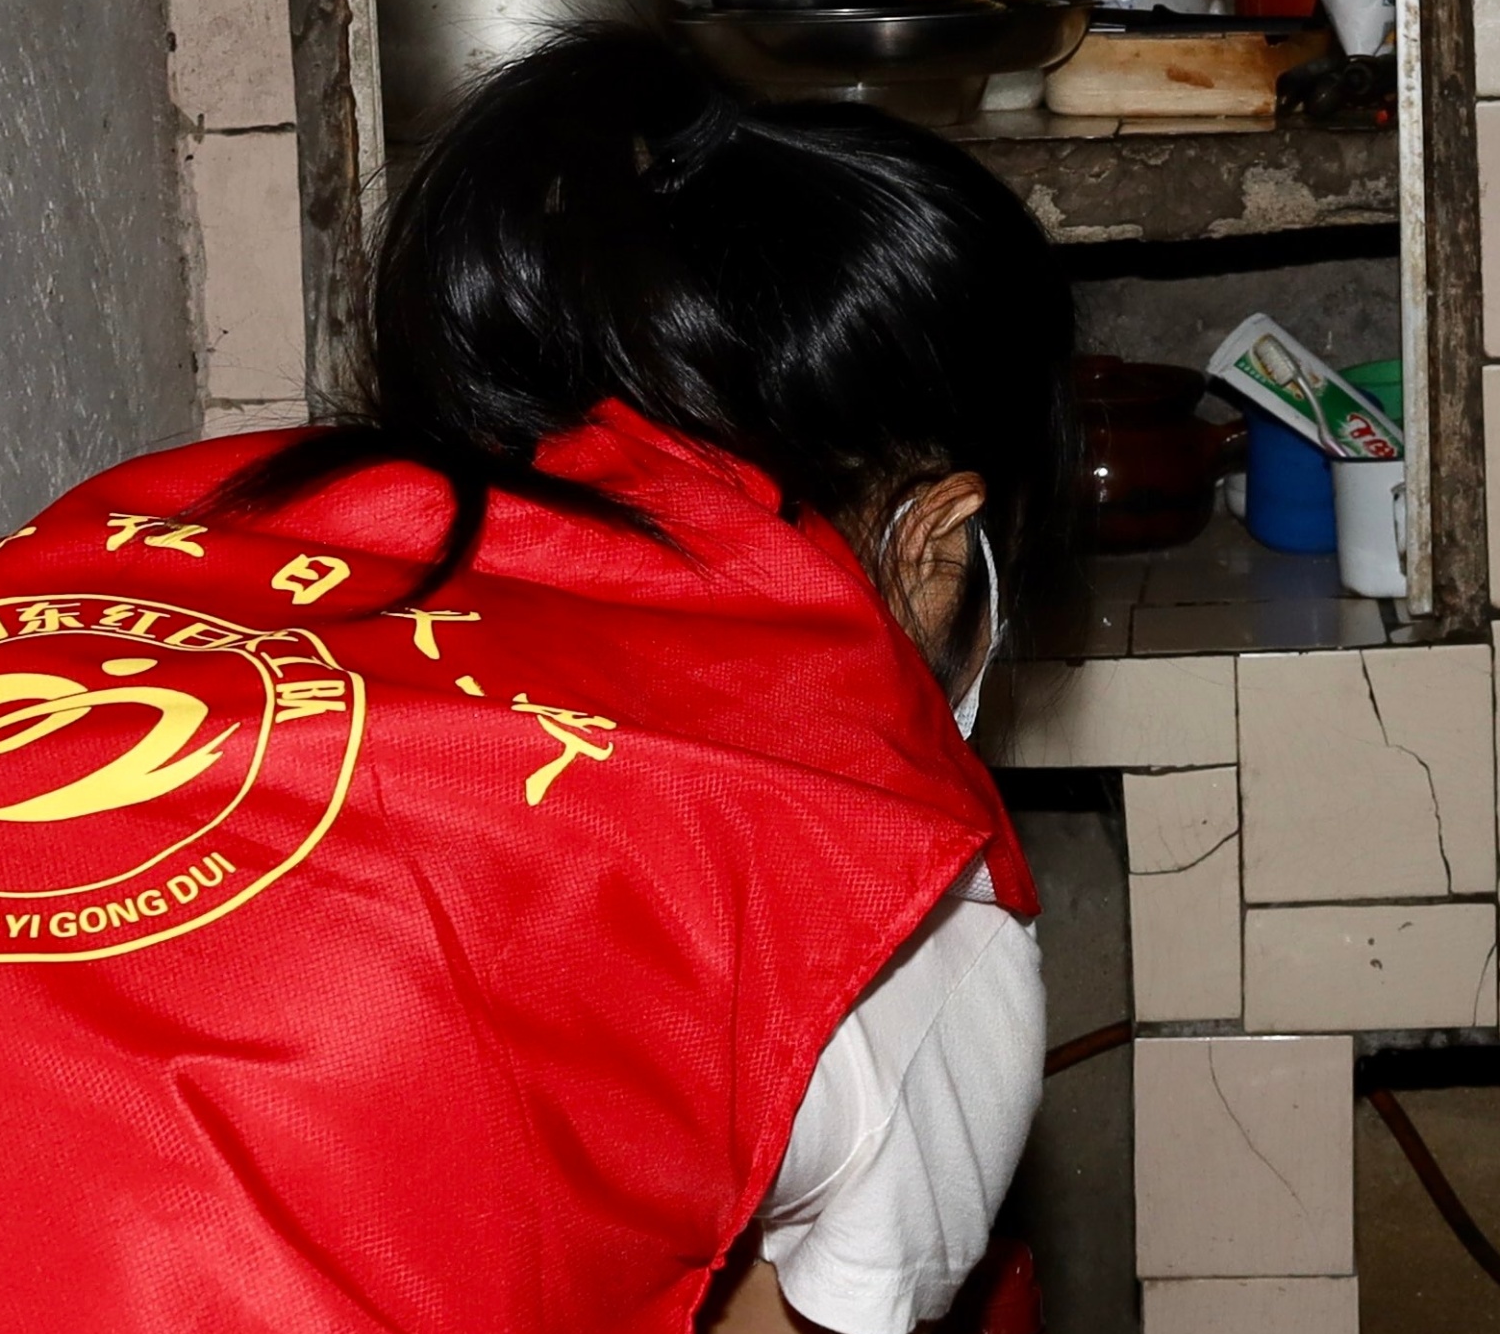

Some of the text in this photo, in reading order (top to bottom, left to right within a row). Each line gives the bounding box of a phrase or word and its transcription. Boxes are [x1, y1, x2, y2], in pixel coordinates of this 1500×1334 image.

[4, 913, 41, 938] YI
[49, 889, 169, 938] GONG
[166, 851, 237, 905] DUI
